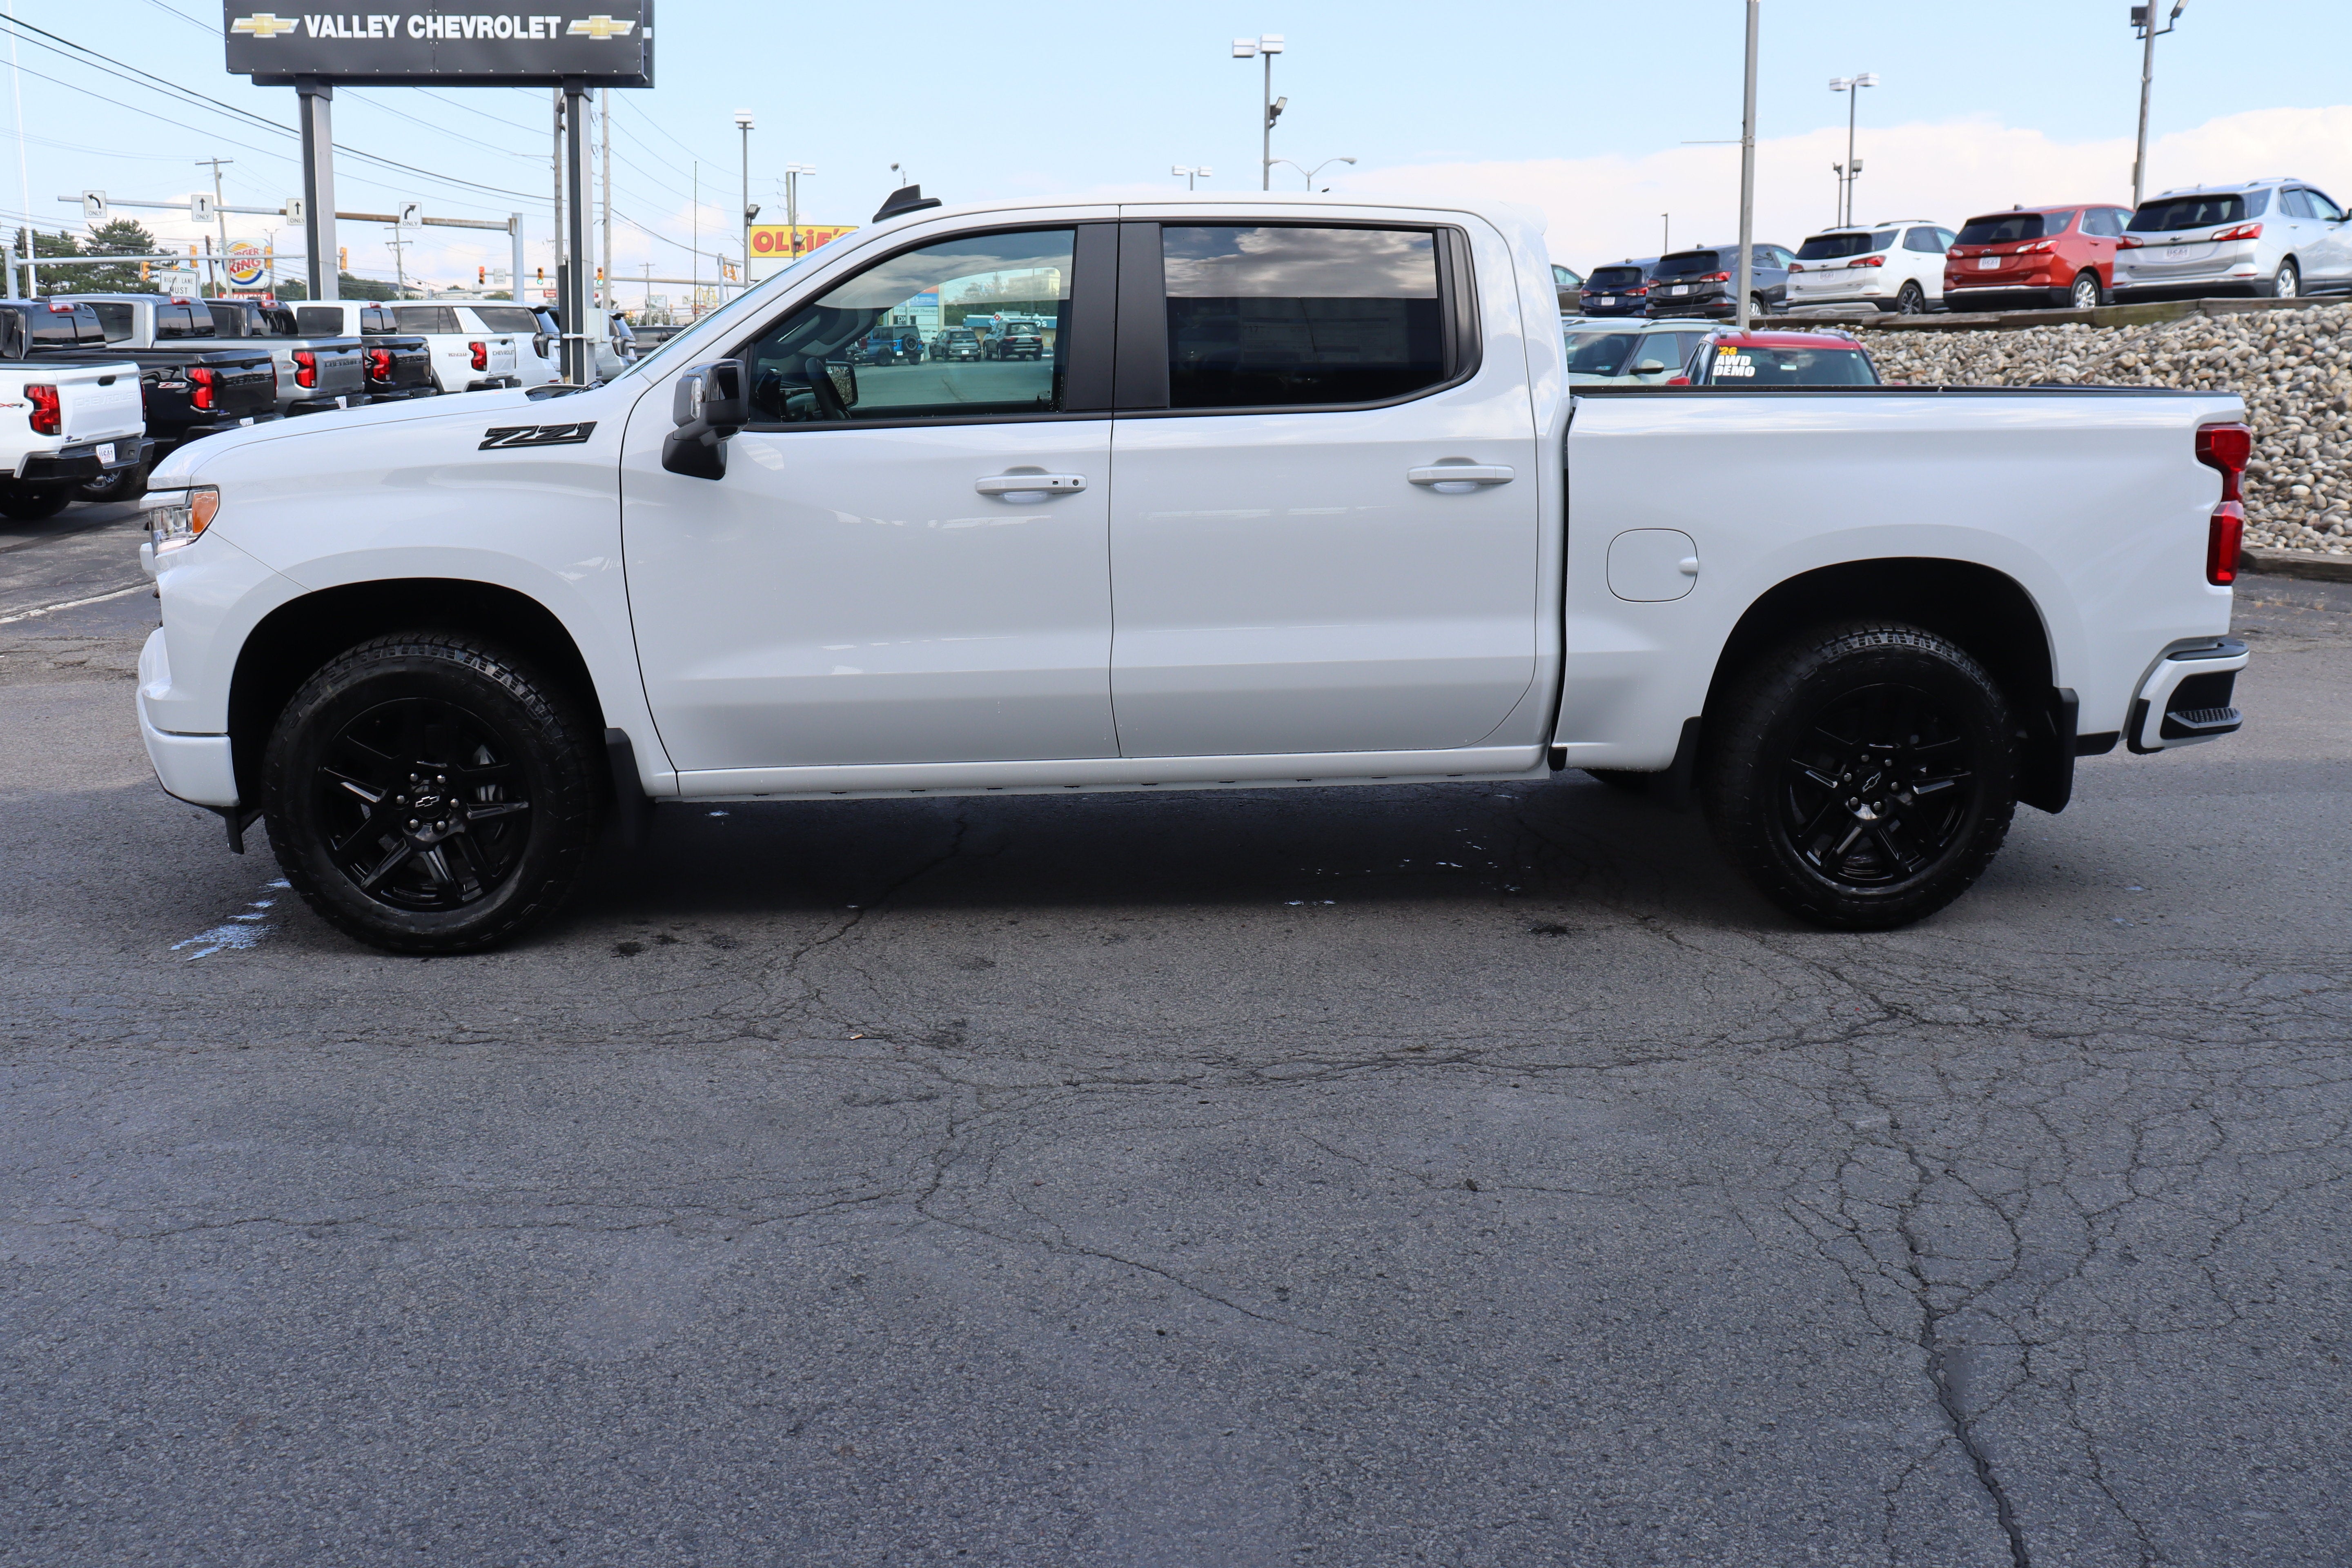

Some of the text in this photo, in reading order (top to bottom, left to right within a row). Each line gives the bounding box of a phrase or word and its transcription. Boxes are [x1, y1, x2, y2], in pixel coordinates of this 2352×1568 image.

[304, 15, 561, 40] VALLEY CHEVROLET
[229, 258, 261, 275] KING
[1719, 347, 1737, 355] '26
[1714, 355, 1751, 366] AWD
[1713, 365, 1755, 377] DEMO
[74, 391, 138, 408] CHEVROLET
[478, 421, 598, 450] Z71
